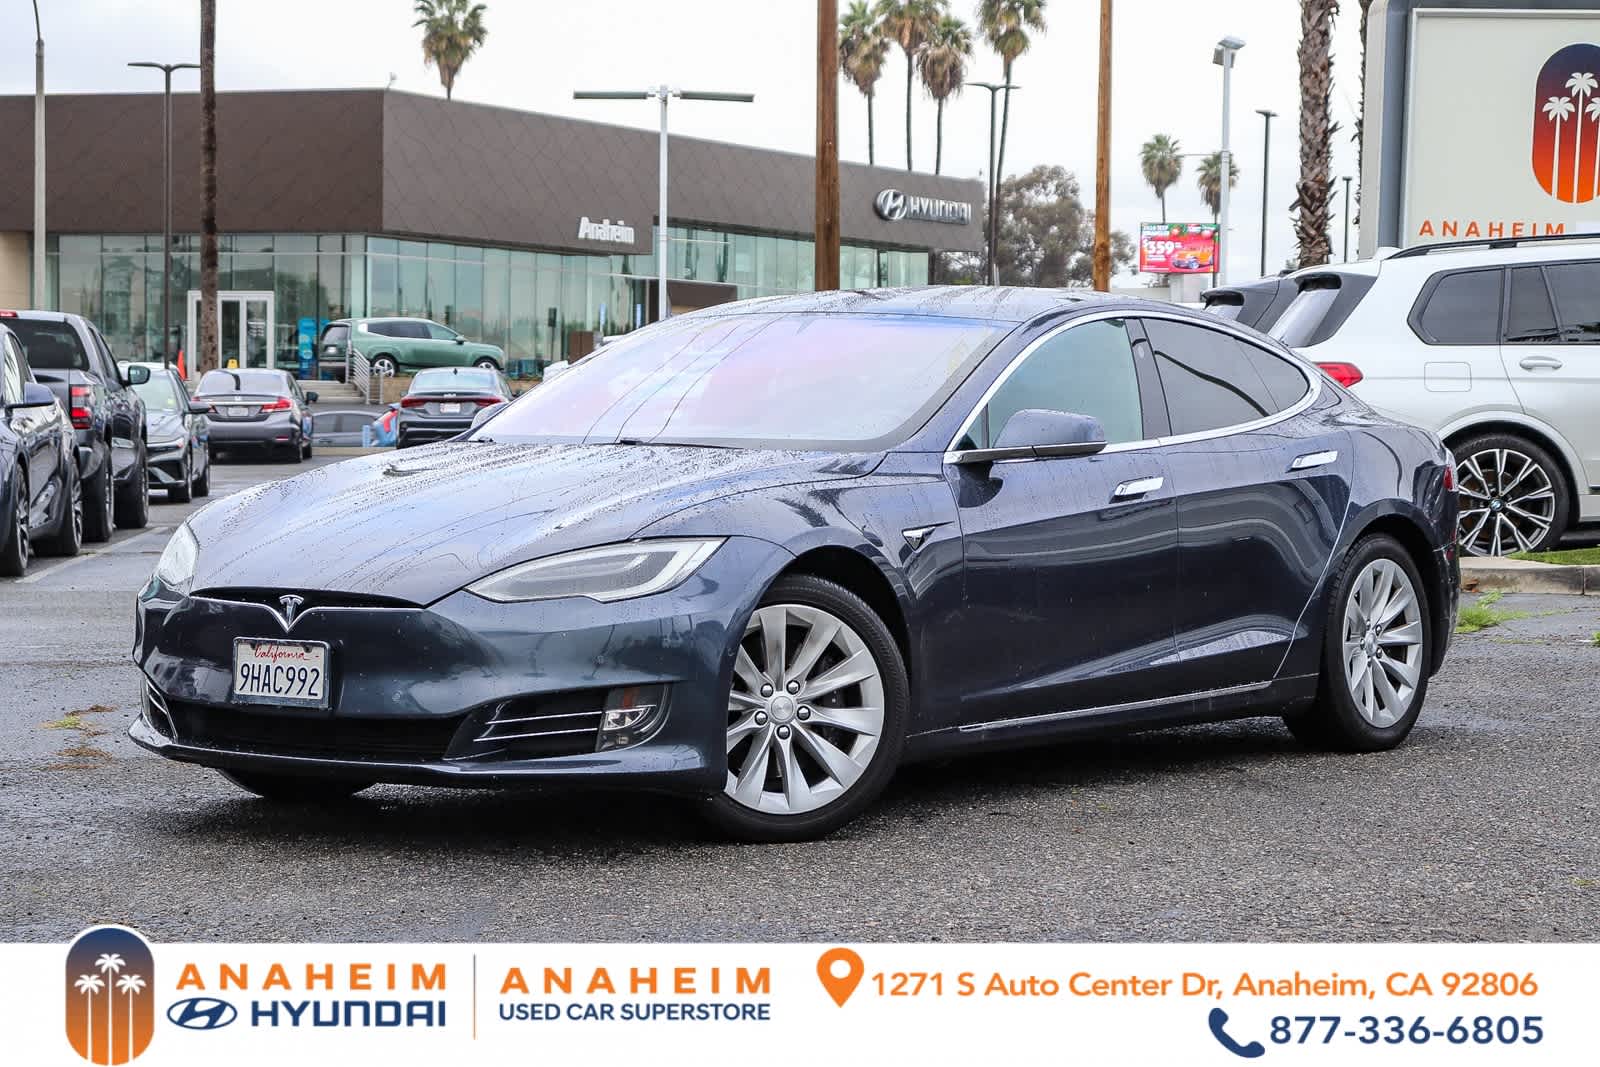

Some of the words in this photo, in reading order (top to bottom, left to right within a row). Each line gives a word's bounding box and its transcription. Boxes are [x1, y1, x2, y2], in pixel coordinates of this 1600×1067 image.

[910, 195, 972, 224] HYUNDAI
[577, 216, 635, 244] Anaheim
[1418, 219, 1565, 237] ANAHEIM
[254, 643, 311, 663] California
[238, 663, 320, 697] 9HAC992
